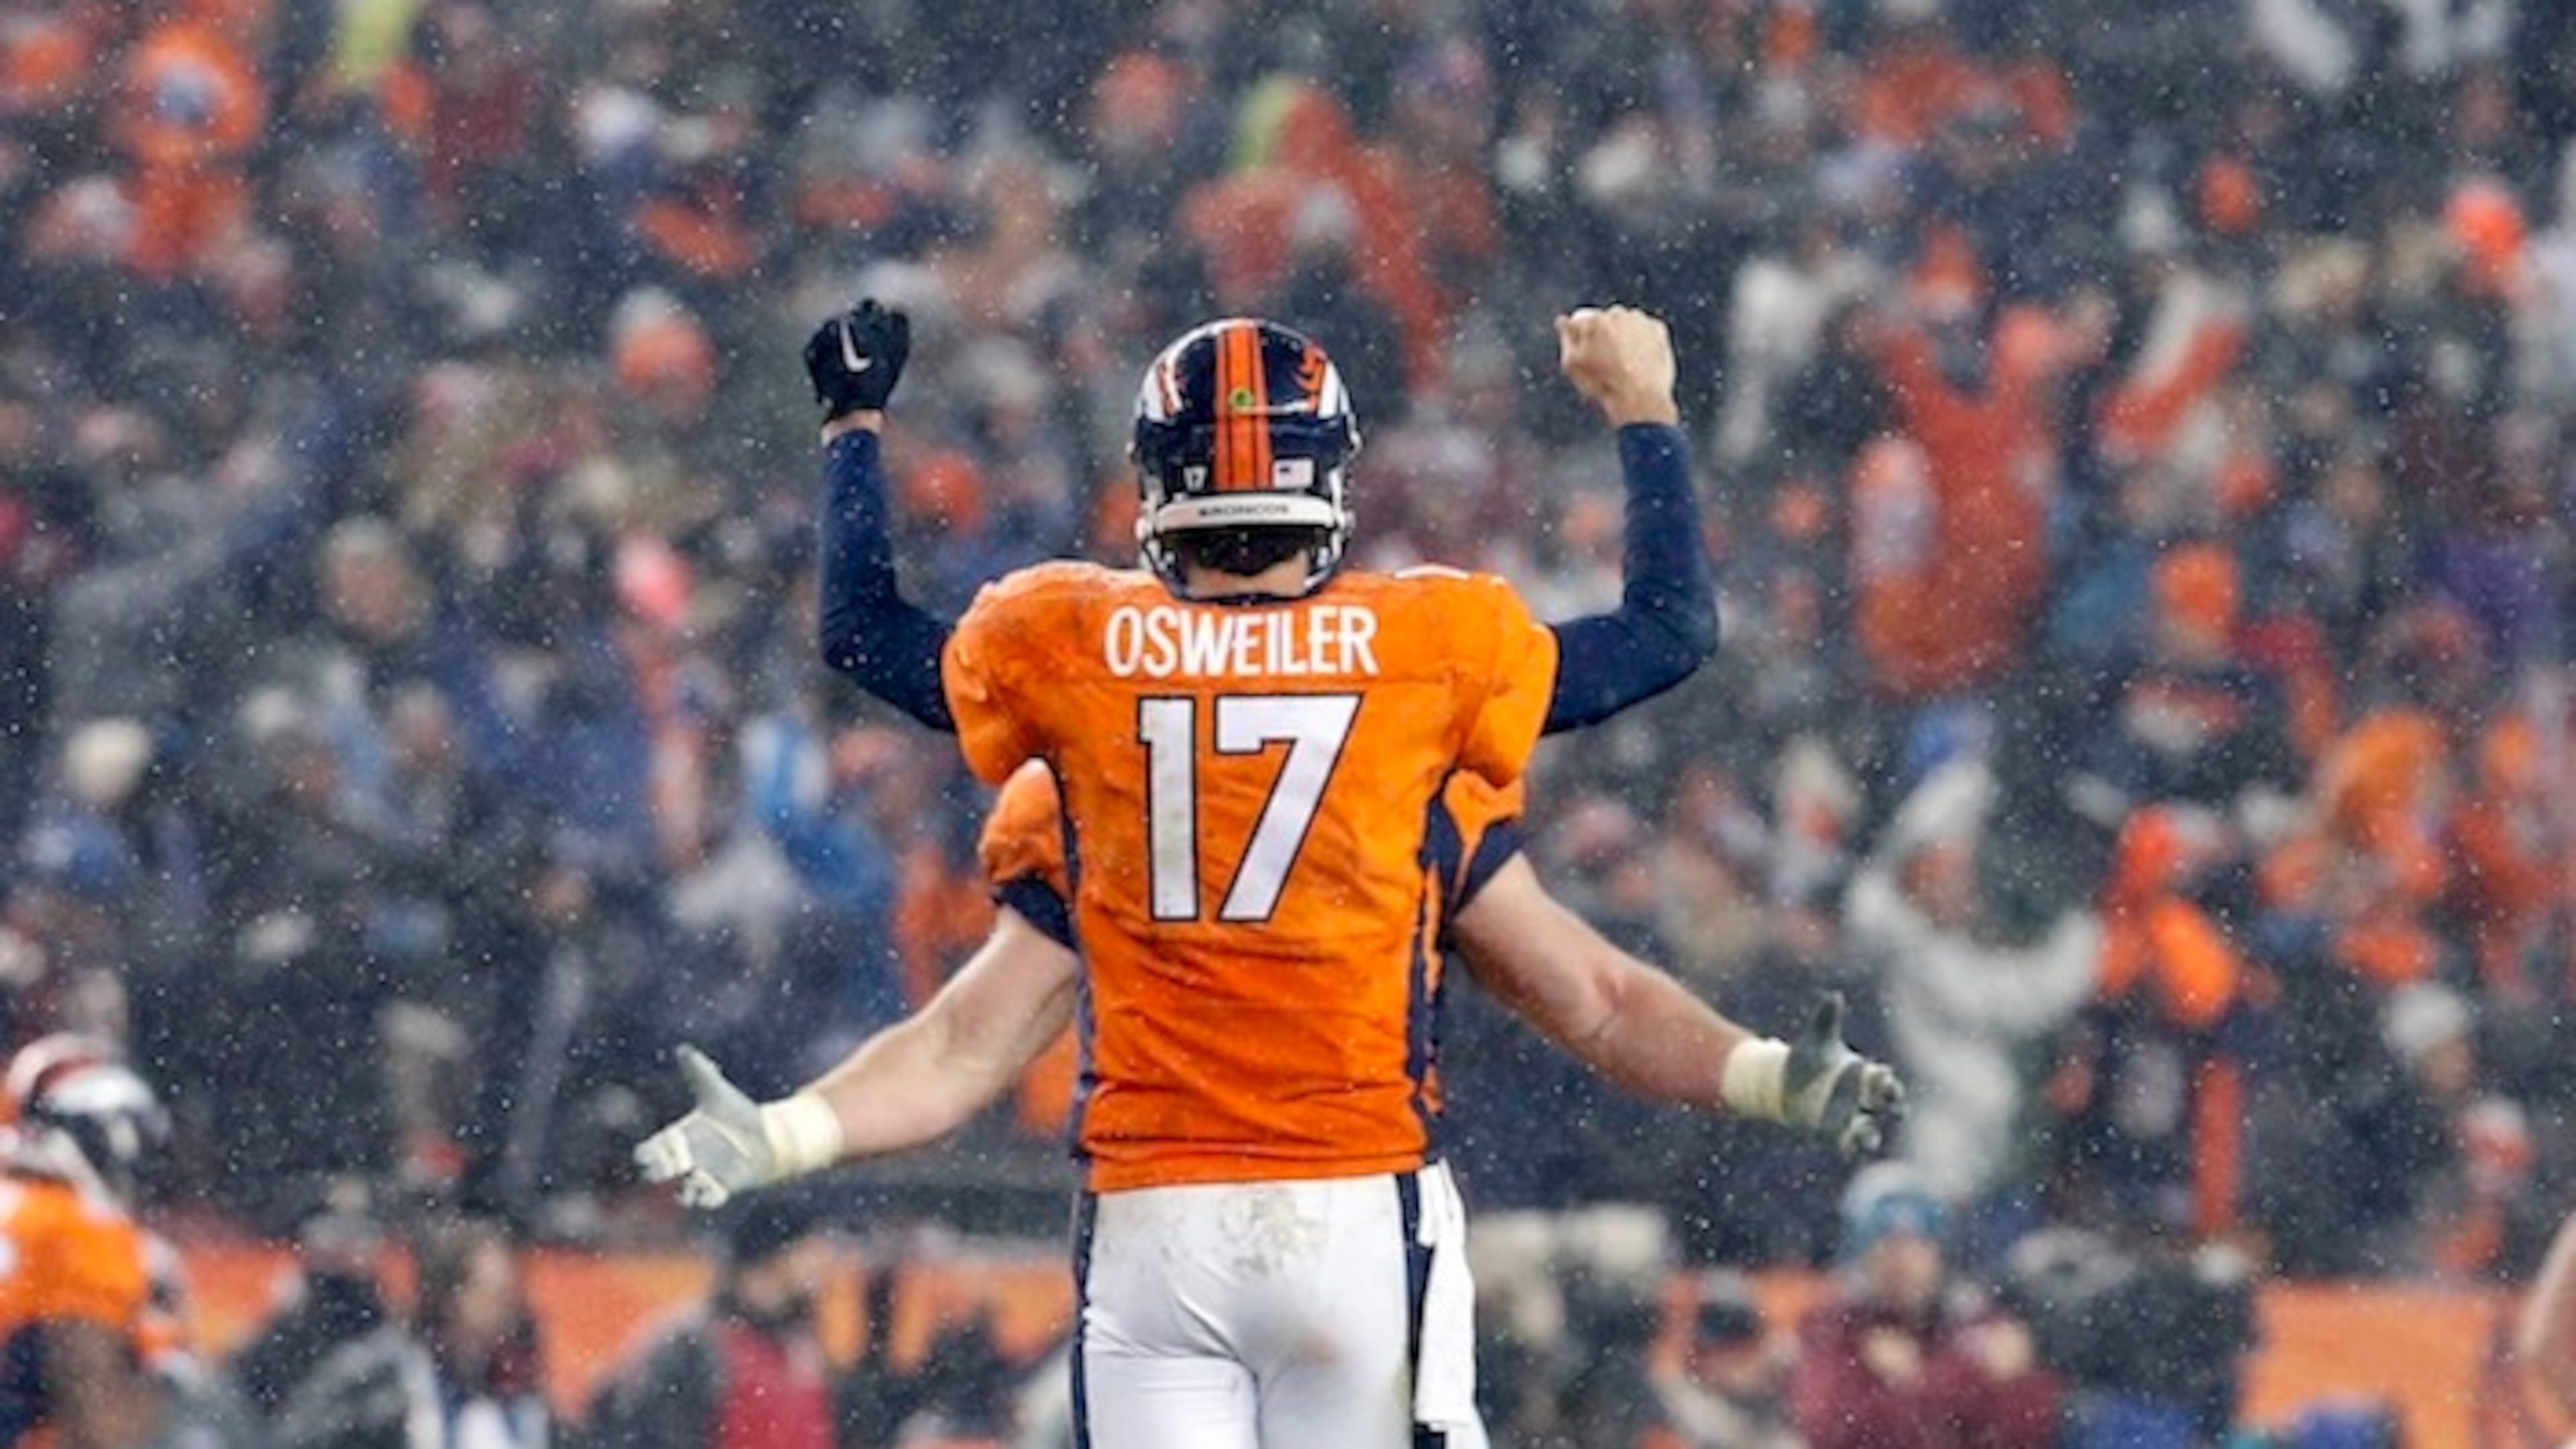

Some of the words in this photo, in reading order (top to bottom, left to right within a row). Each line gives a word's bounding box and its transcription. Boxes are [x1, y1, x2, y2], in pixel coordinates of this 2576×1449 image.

[1198, 504, 1289, 517] BRONCOS
[1105, 605, 1379, 678] OSWEILER
[1136, 692, 1364, 922] 17
